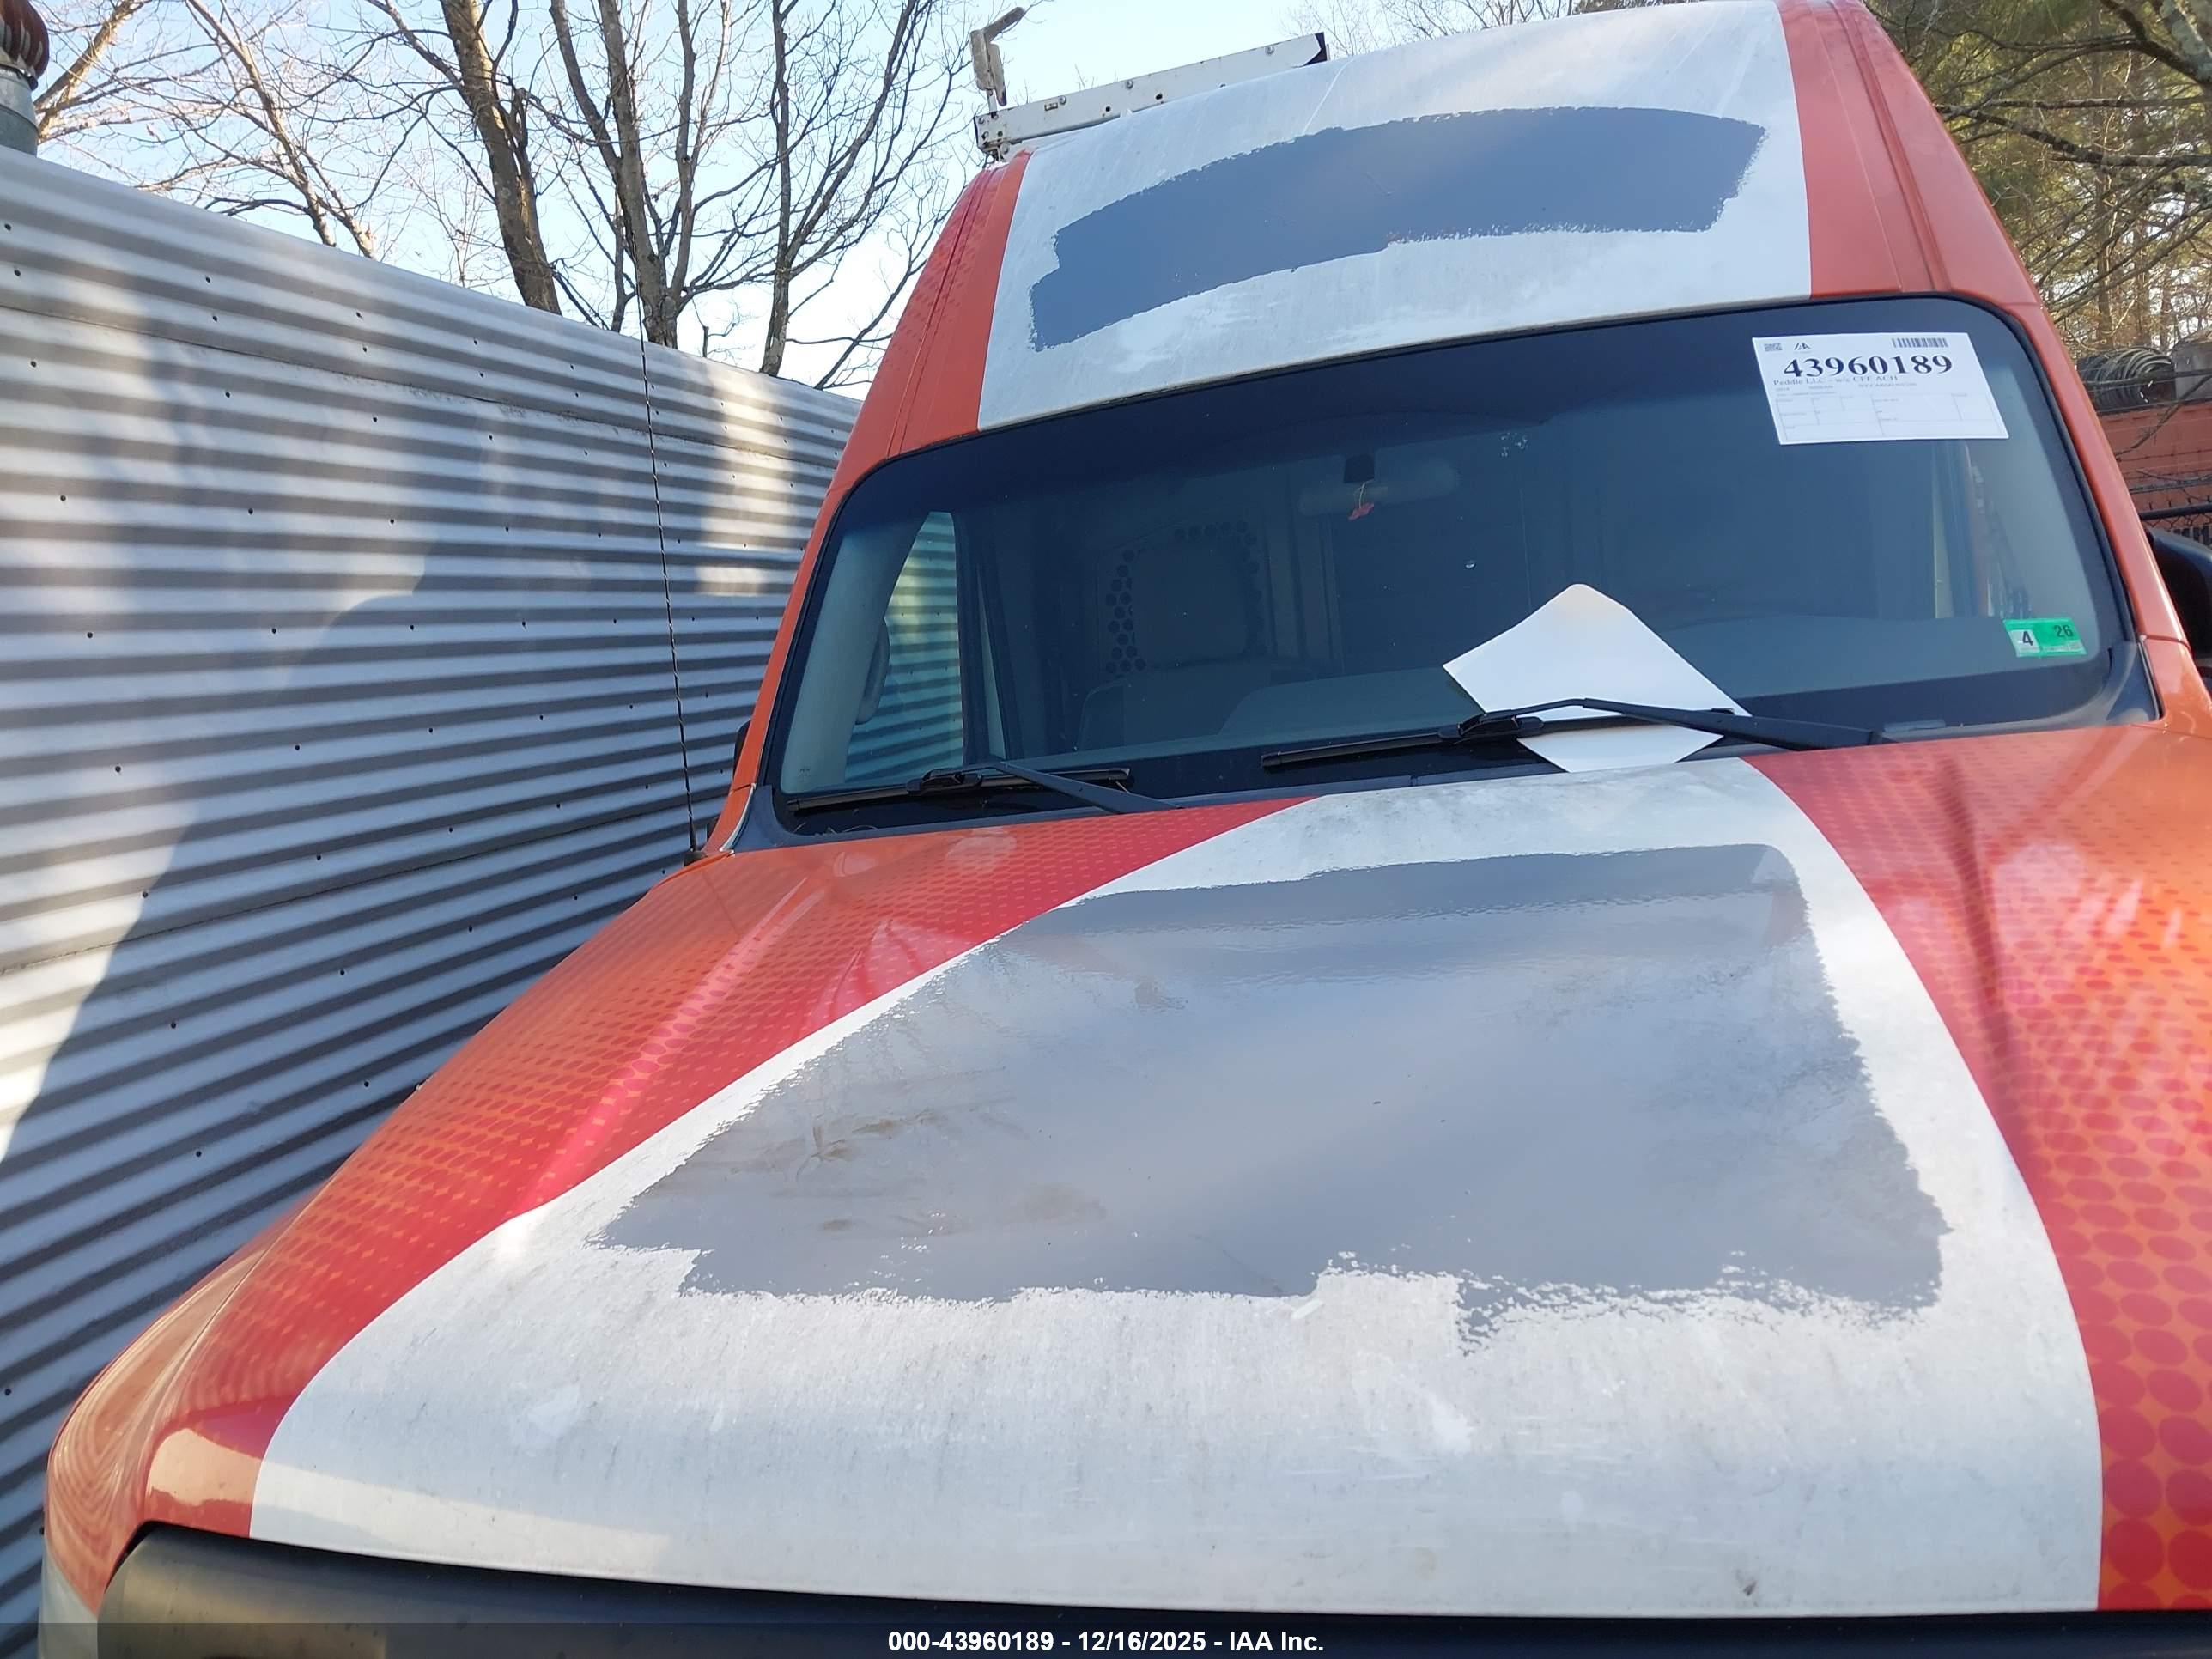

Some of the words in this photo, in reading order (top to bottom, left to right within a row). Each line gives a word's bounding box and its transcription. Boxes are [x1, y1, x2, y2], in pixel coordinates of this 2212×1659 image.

[1784, 355, 1952, 377] 43960189
[2022, 630, 2034, 646] 4
[2054, 624, 2073, 637] 26
